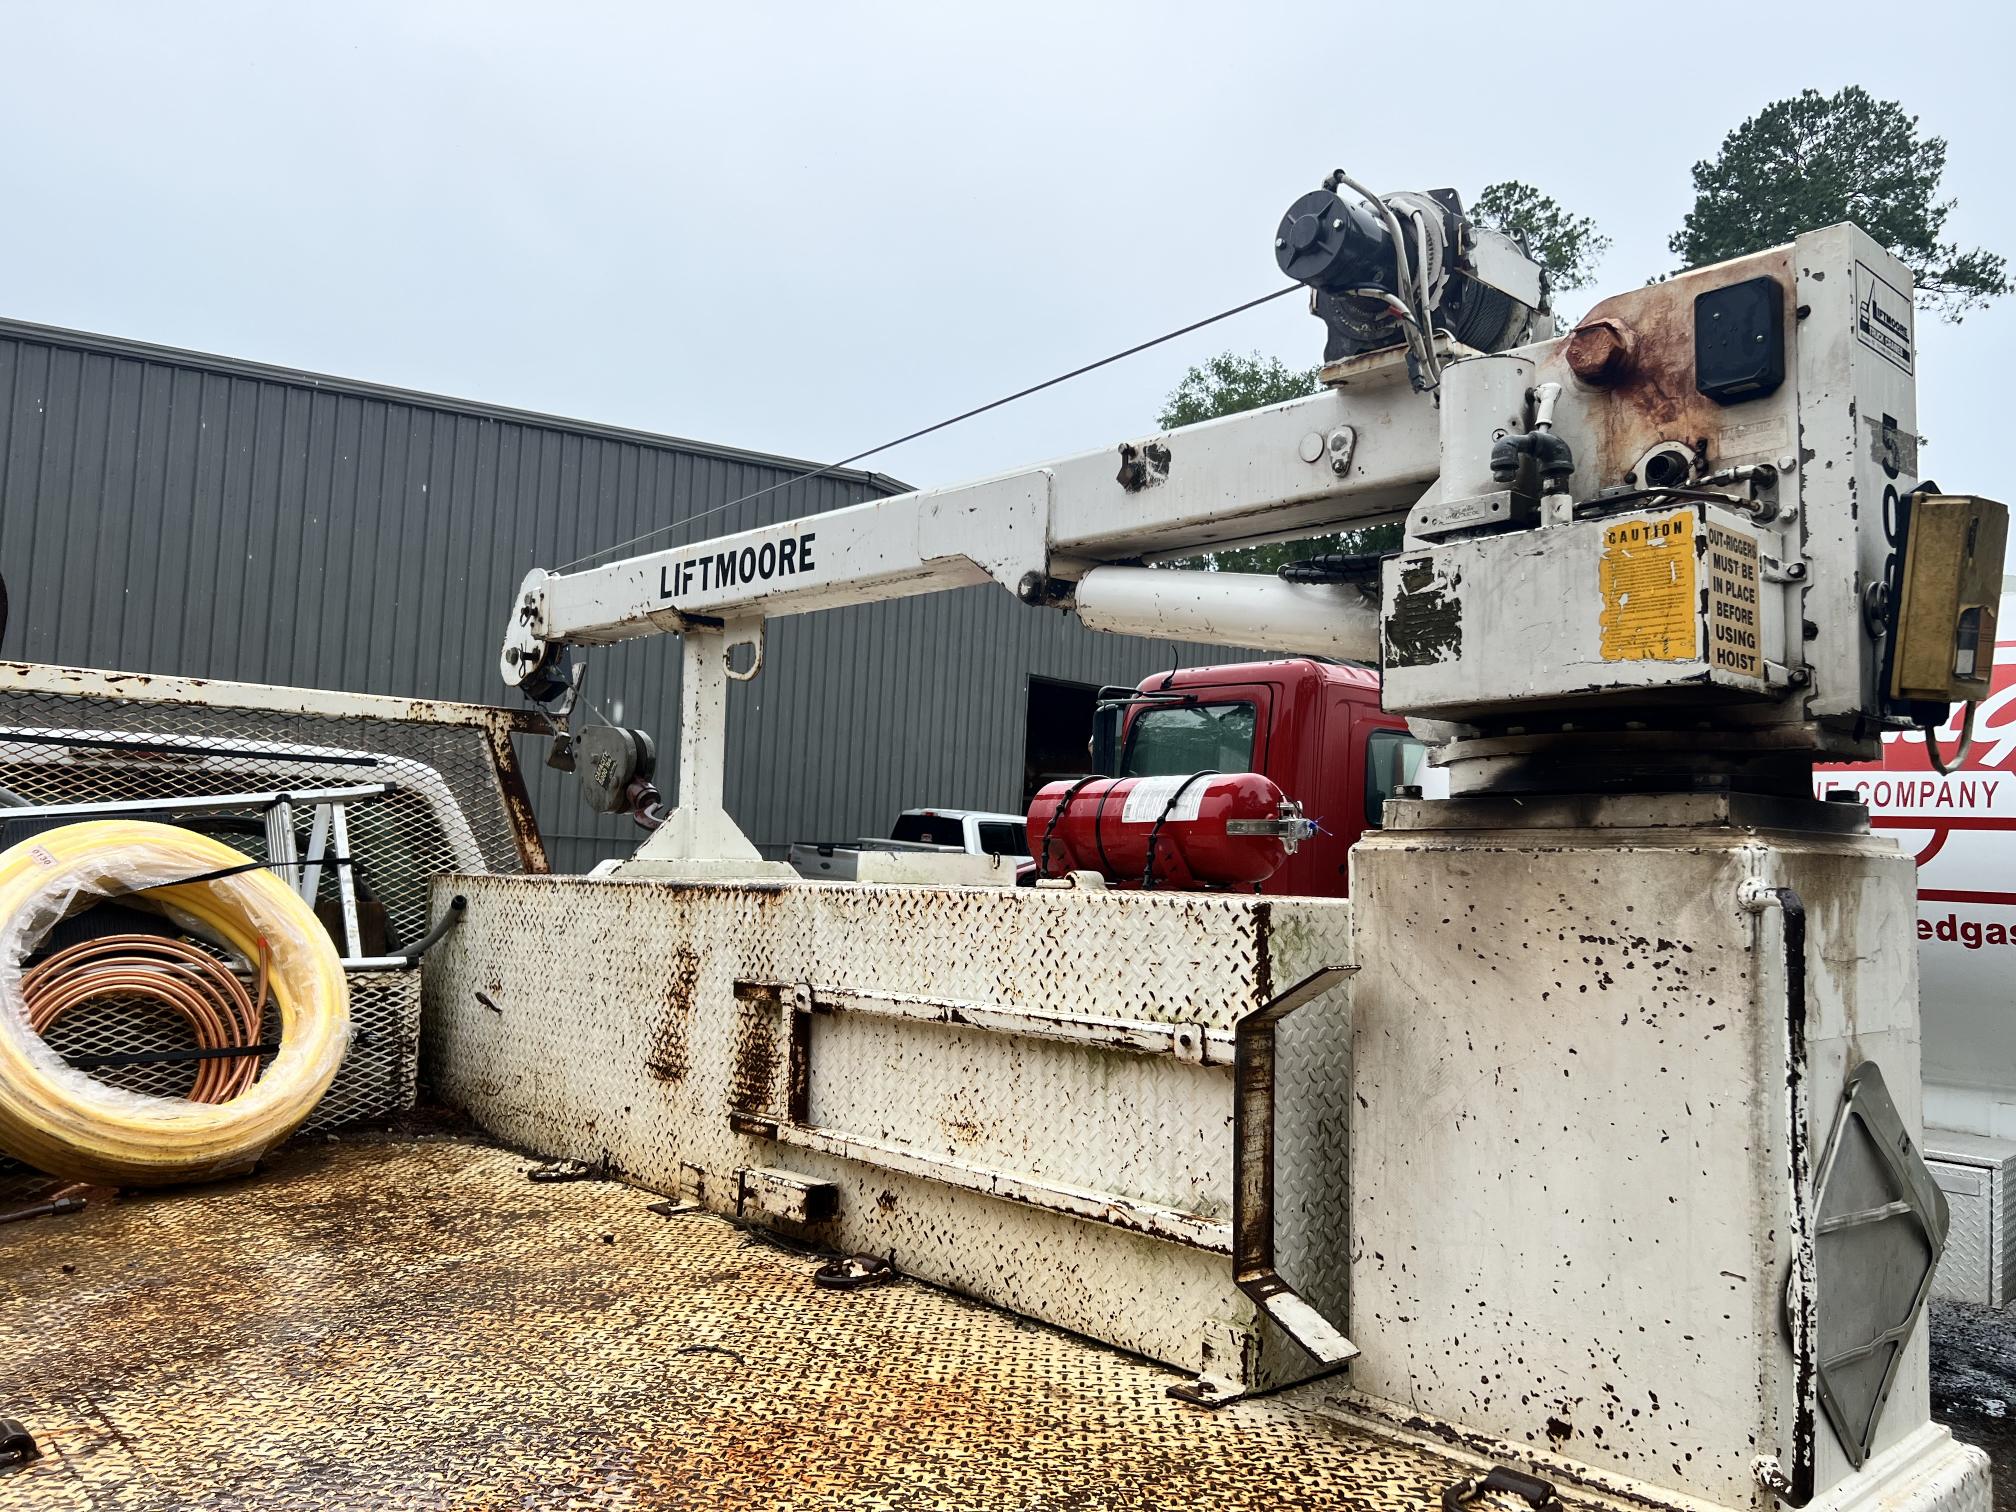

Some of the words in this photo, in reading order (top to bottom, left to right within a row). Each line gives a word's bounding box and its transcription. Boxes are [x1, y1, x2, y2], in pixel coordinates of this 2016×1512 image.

[1608, 520, 1682, 545] CAUTION
[1708, 527, 1758, 560] OUT-RIGGERS
[660, 532, 816, 600] LIFTMOORE
[1713, 552, 1741, 576] MUST
[1741, 564, 1754, 581] BE
[1713, 575, 1723, 593] IN
[1725, 581, 1755, 604] PLACE
[1716, 600, 1754, 626] BEFORE
[1715, 623, 1756, 649] USING
[1716, 647, 1756, 672] HOIST
